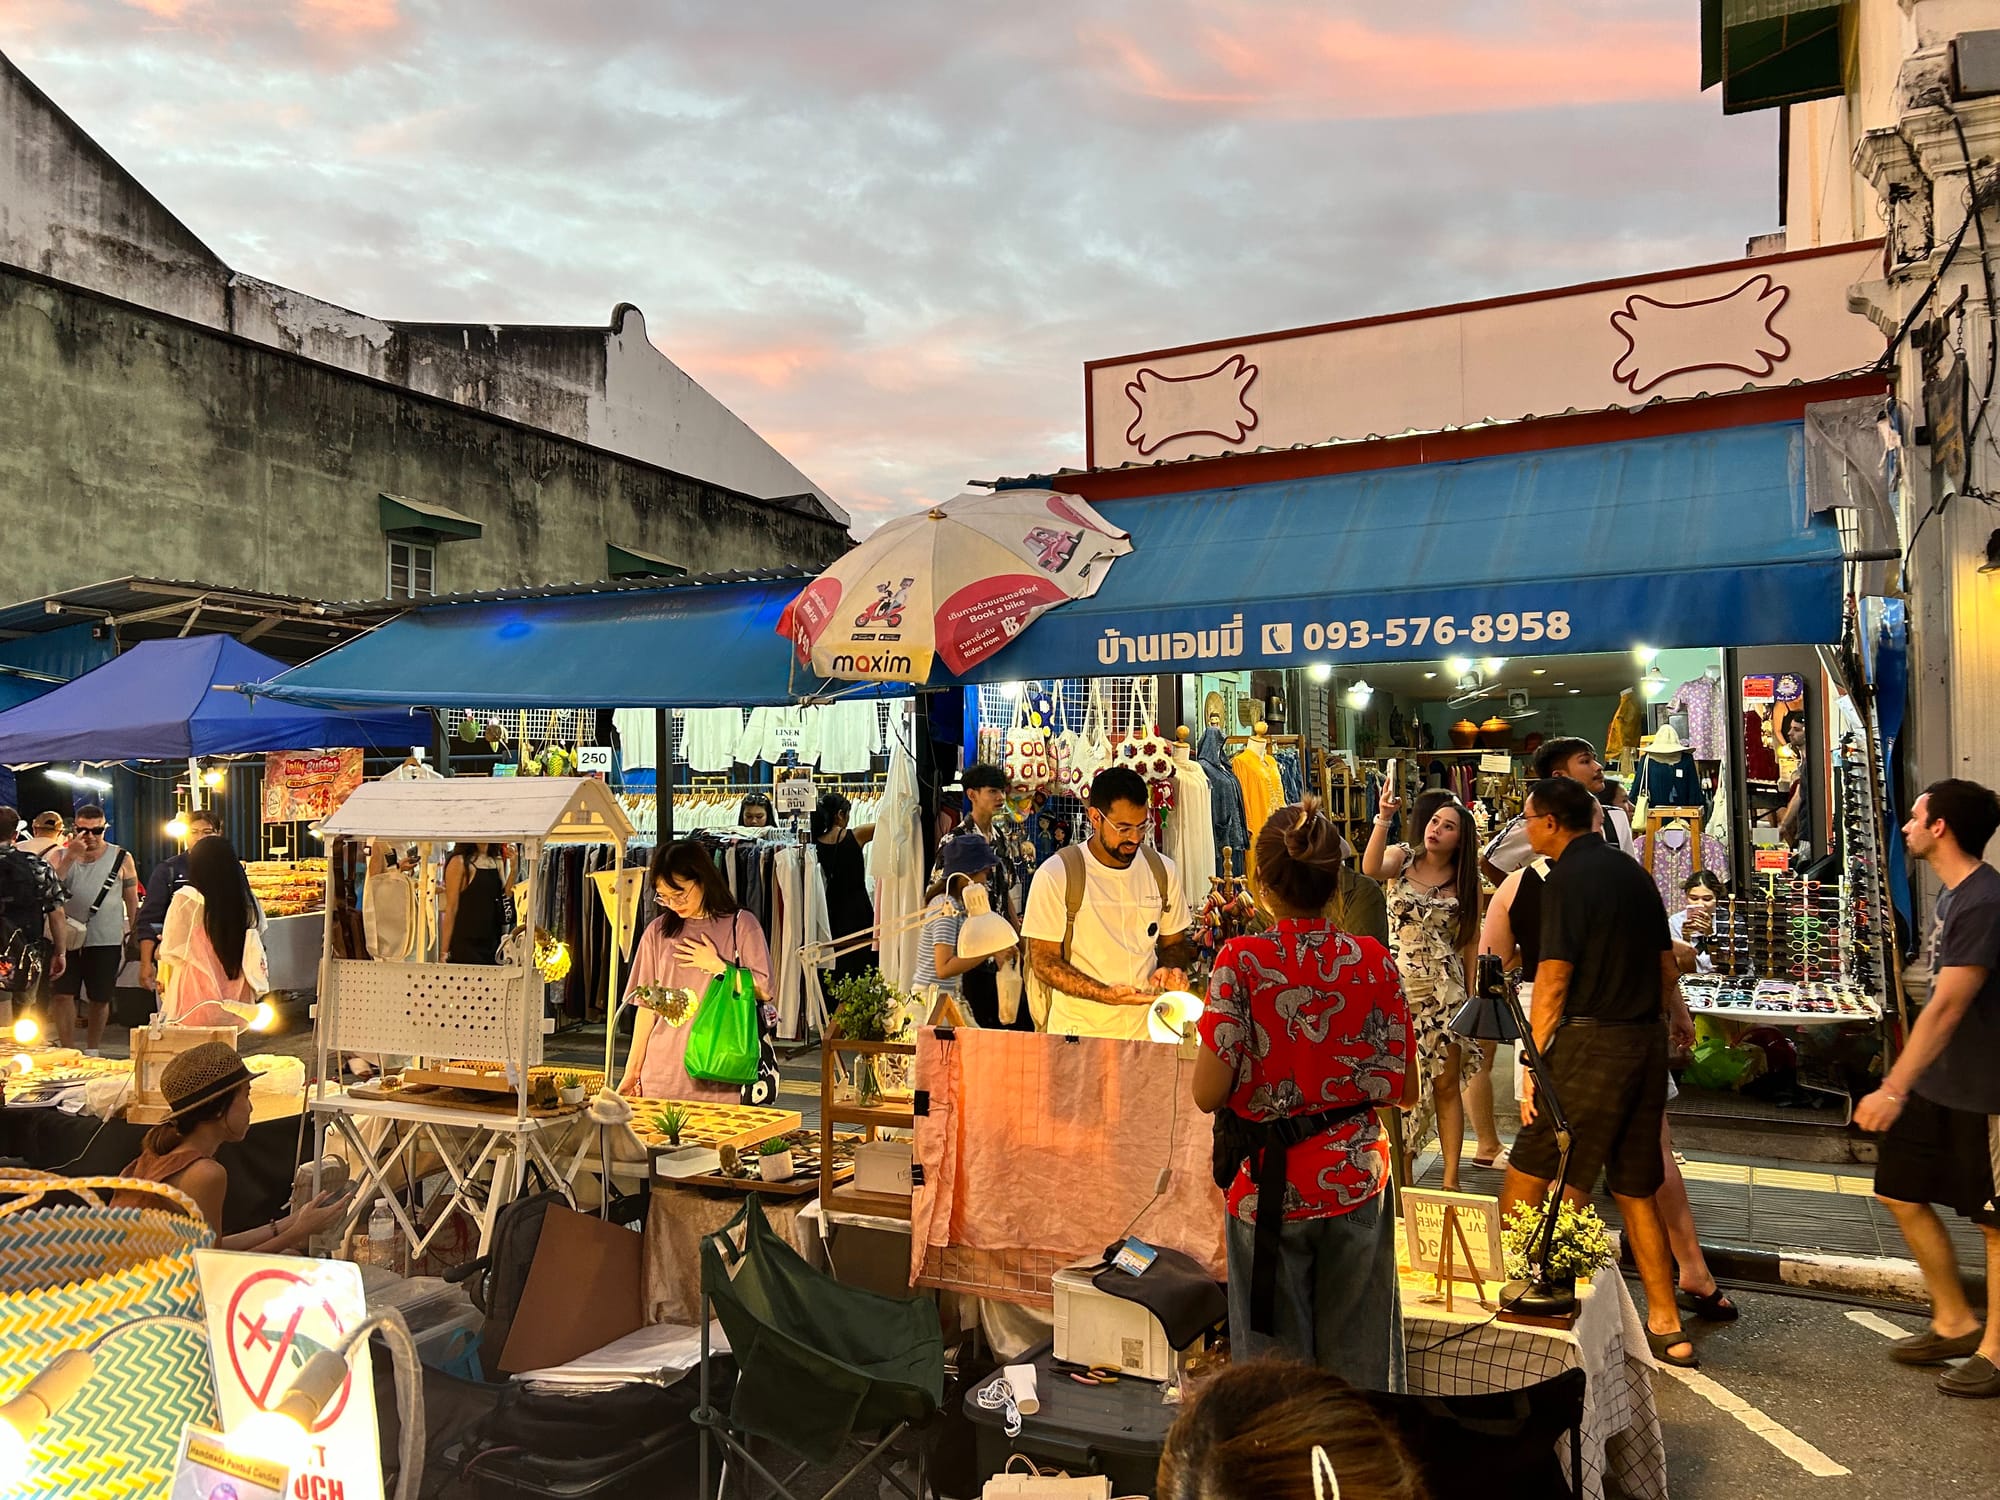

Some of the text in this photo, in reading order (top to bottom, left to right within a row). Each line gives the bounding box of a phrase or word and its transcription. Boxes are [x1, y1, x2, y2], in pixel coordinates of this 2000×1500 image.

[969, 609, 996, 623] Book
[1004, 599, 1026, 611] bike
[1098, 614, 1243, 665] บ้านเอมมี่
[1303, 610, 1571, 651] 093-576-8958
[963, 636, 1000, 659] Rides from
[832, 649, 911, 674] maxim
[581, 752, 607, 764] 250
[781, 787, 810, 797] LINEN
